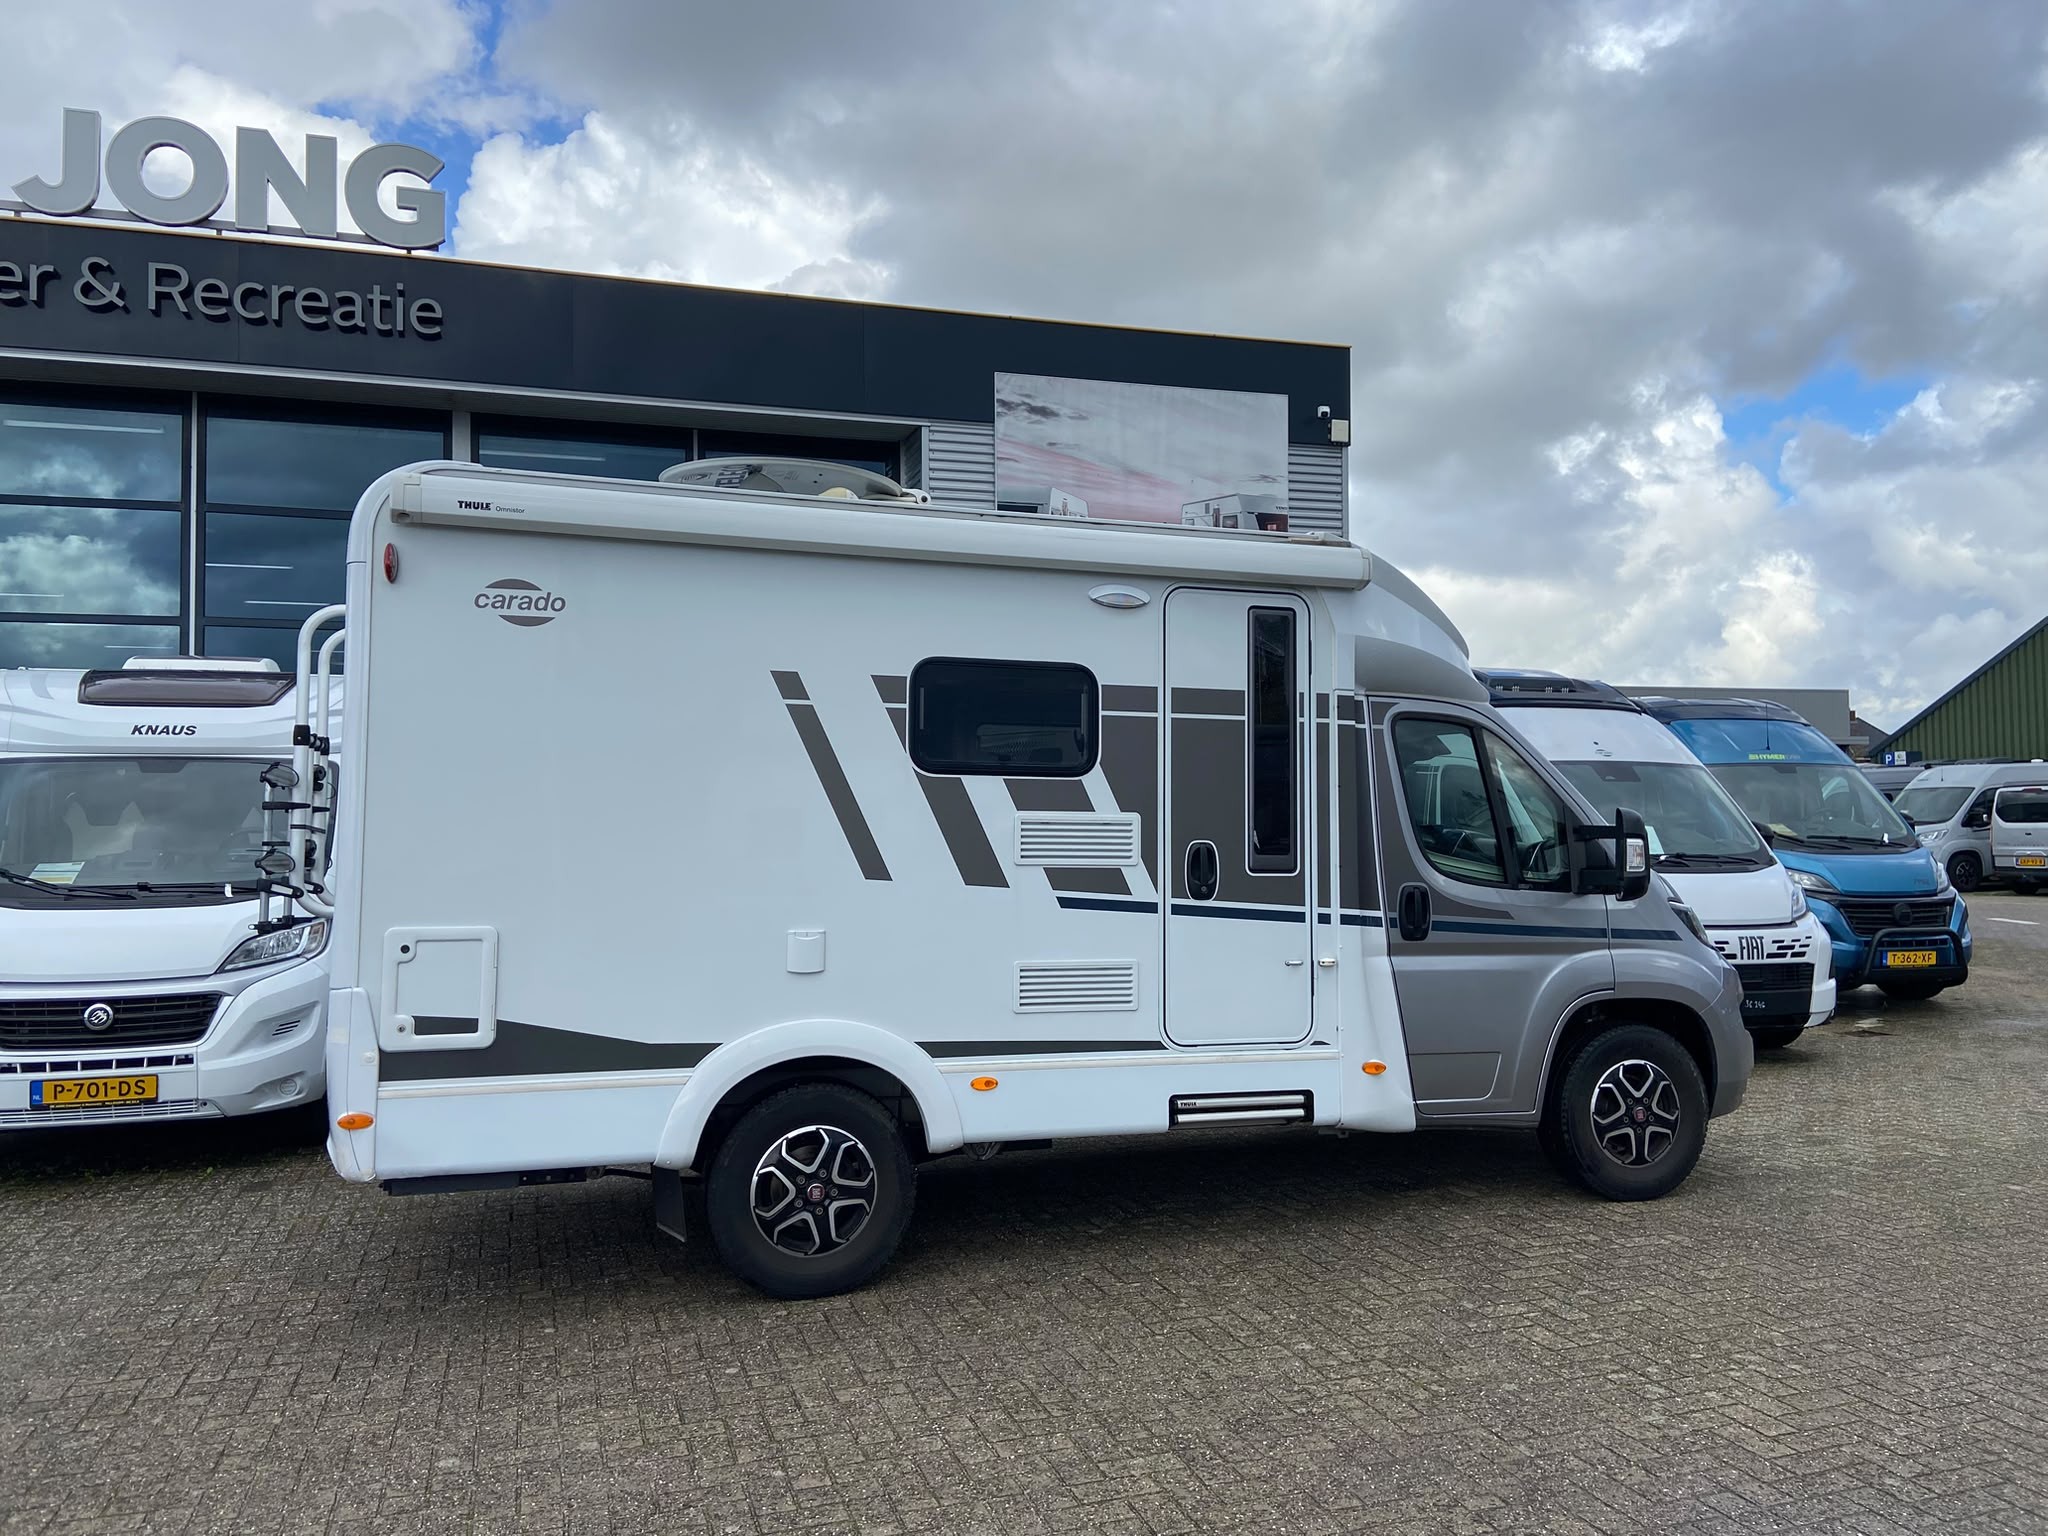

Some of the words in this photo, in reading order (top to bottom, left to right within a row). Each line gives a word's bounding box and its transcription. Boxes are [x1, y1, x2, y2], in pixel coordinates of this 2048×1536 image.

[11, 106, 446, 249] JONG
[73, 256, 125, 308] &
[147, 261, 444, 335] Recreatie
[457, 500, 492, 511] THULE
[495, 505, 525, 514] Omnistor
[474, 592, 566, 612] carado
[130, 724, 197, 736] KNAUS
[1885, 754, 1892, 765] P
[1738, 936, 1764, 960] FIAT
[53, 1079, 146, 1100] P-701-DS
